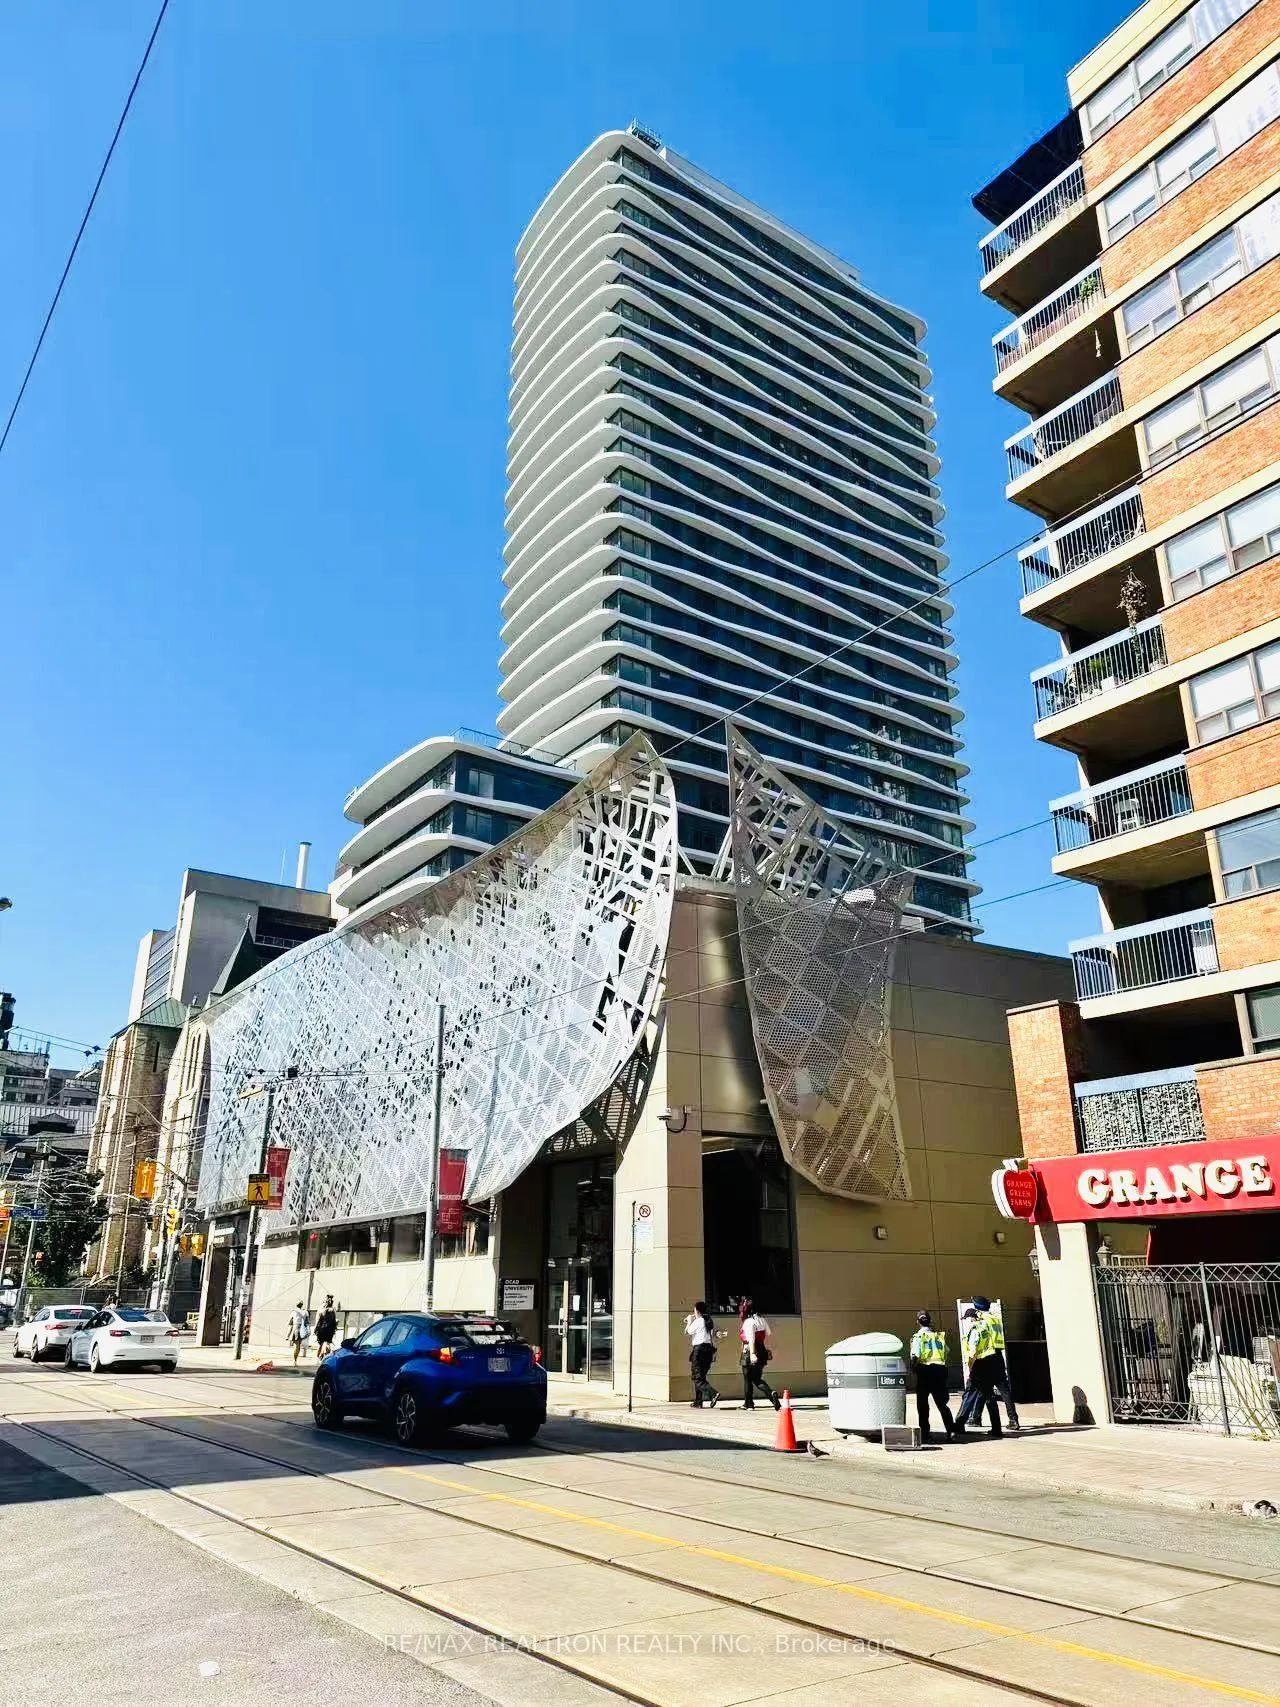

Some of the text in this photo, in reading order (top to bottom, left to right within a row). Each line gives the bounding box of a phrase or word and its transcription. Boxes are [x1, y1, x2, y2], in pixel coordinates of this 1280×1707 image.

[1006, 1180, 1033, 1189] GRANGE
[1077, 1155, 1272, 1206] GRANGE
[1009, 1189, 1031, 1198] GREEN
[1010, 1198, 1032, 1207] FARMS
[880, 1376, 896, 1385] Litter
